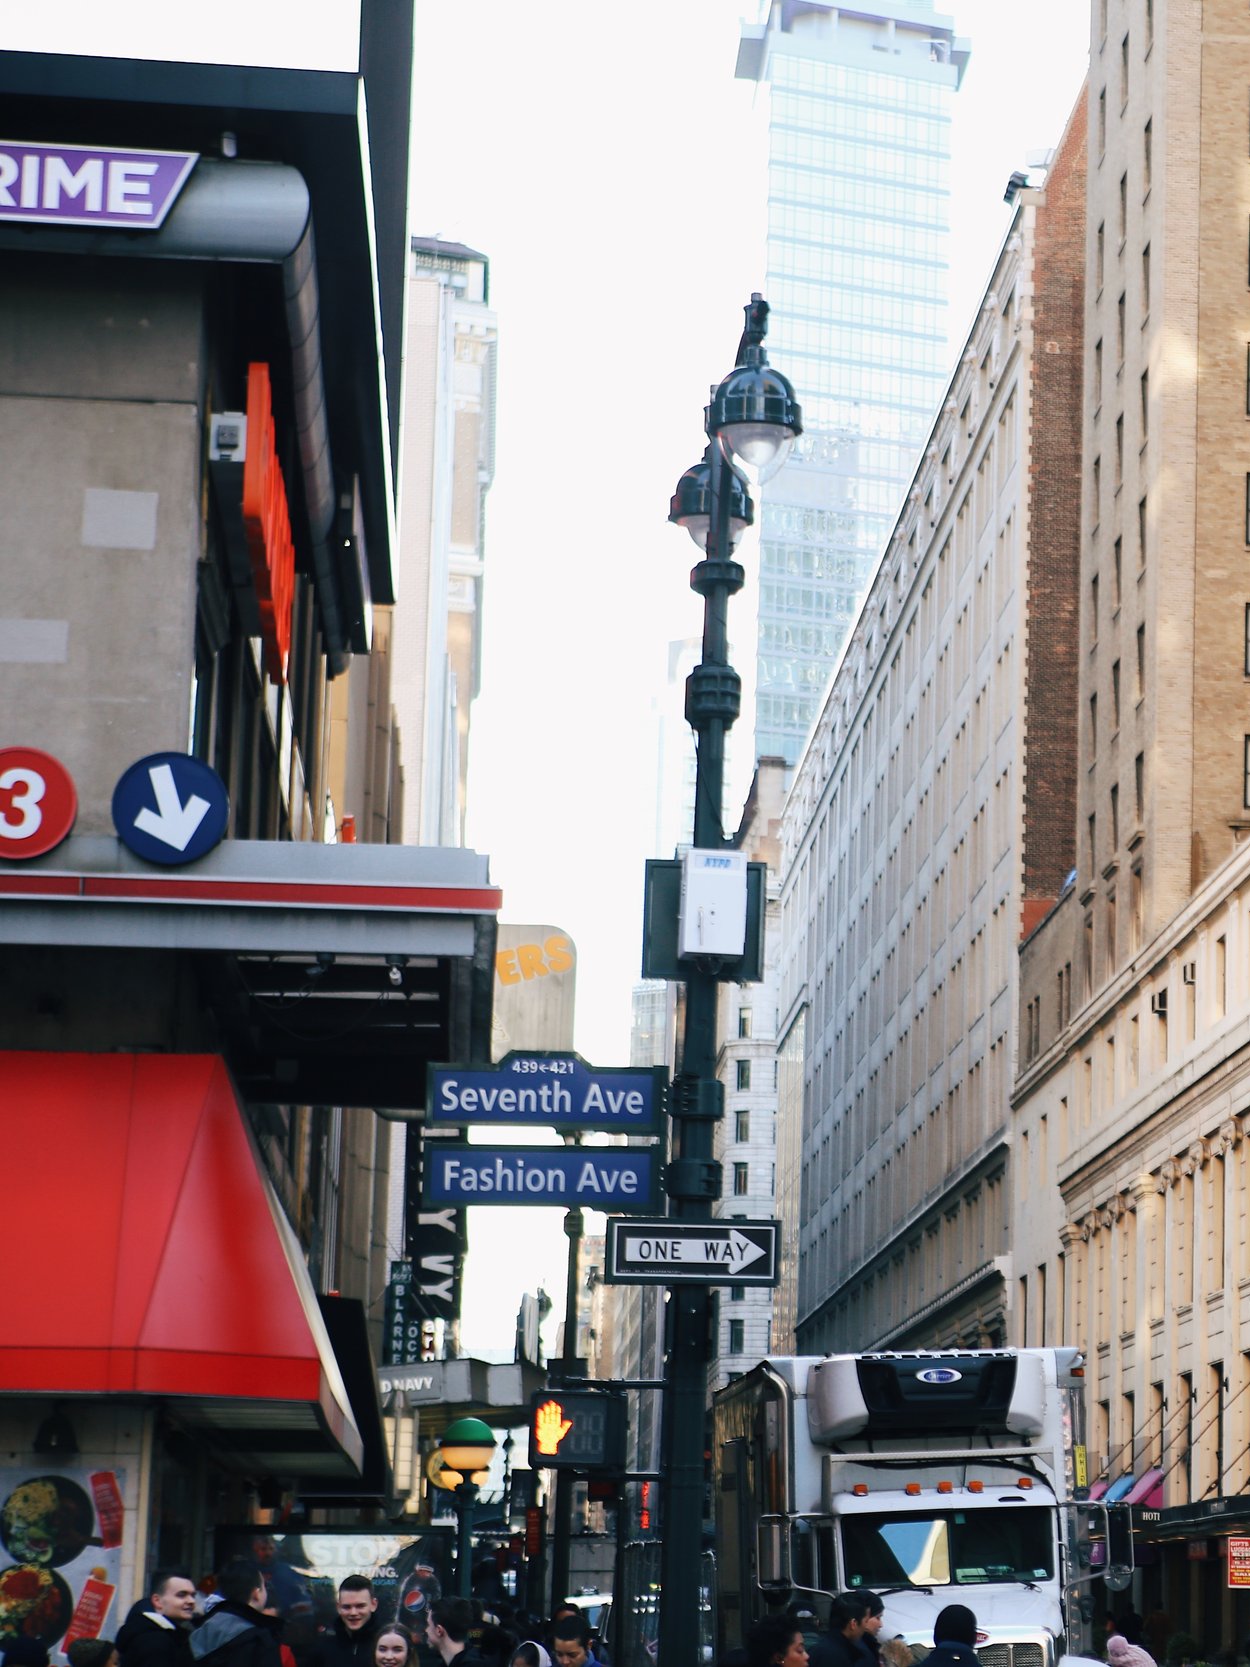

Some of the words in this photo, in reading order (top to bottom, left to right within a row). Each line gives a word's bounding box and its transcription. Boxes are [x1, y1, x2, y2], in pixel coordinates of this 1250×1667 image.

[0, 767, 46, 840] 3
[441, 1080, 571, 1113] Seventh
[582, 1082, 644, 1115] Ave
[444, 1158, 566, 1193] Fashion
[577, 1162, 638, 1193] Ave
[639, 1240, 682, 1260] ONE
[704, 1242, 749, 1261] WAY
[394, 1376, 433, 1392] NAVY
[311, 1539, 401, 1566] STOP
